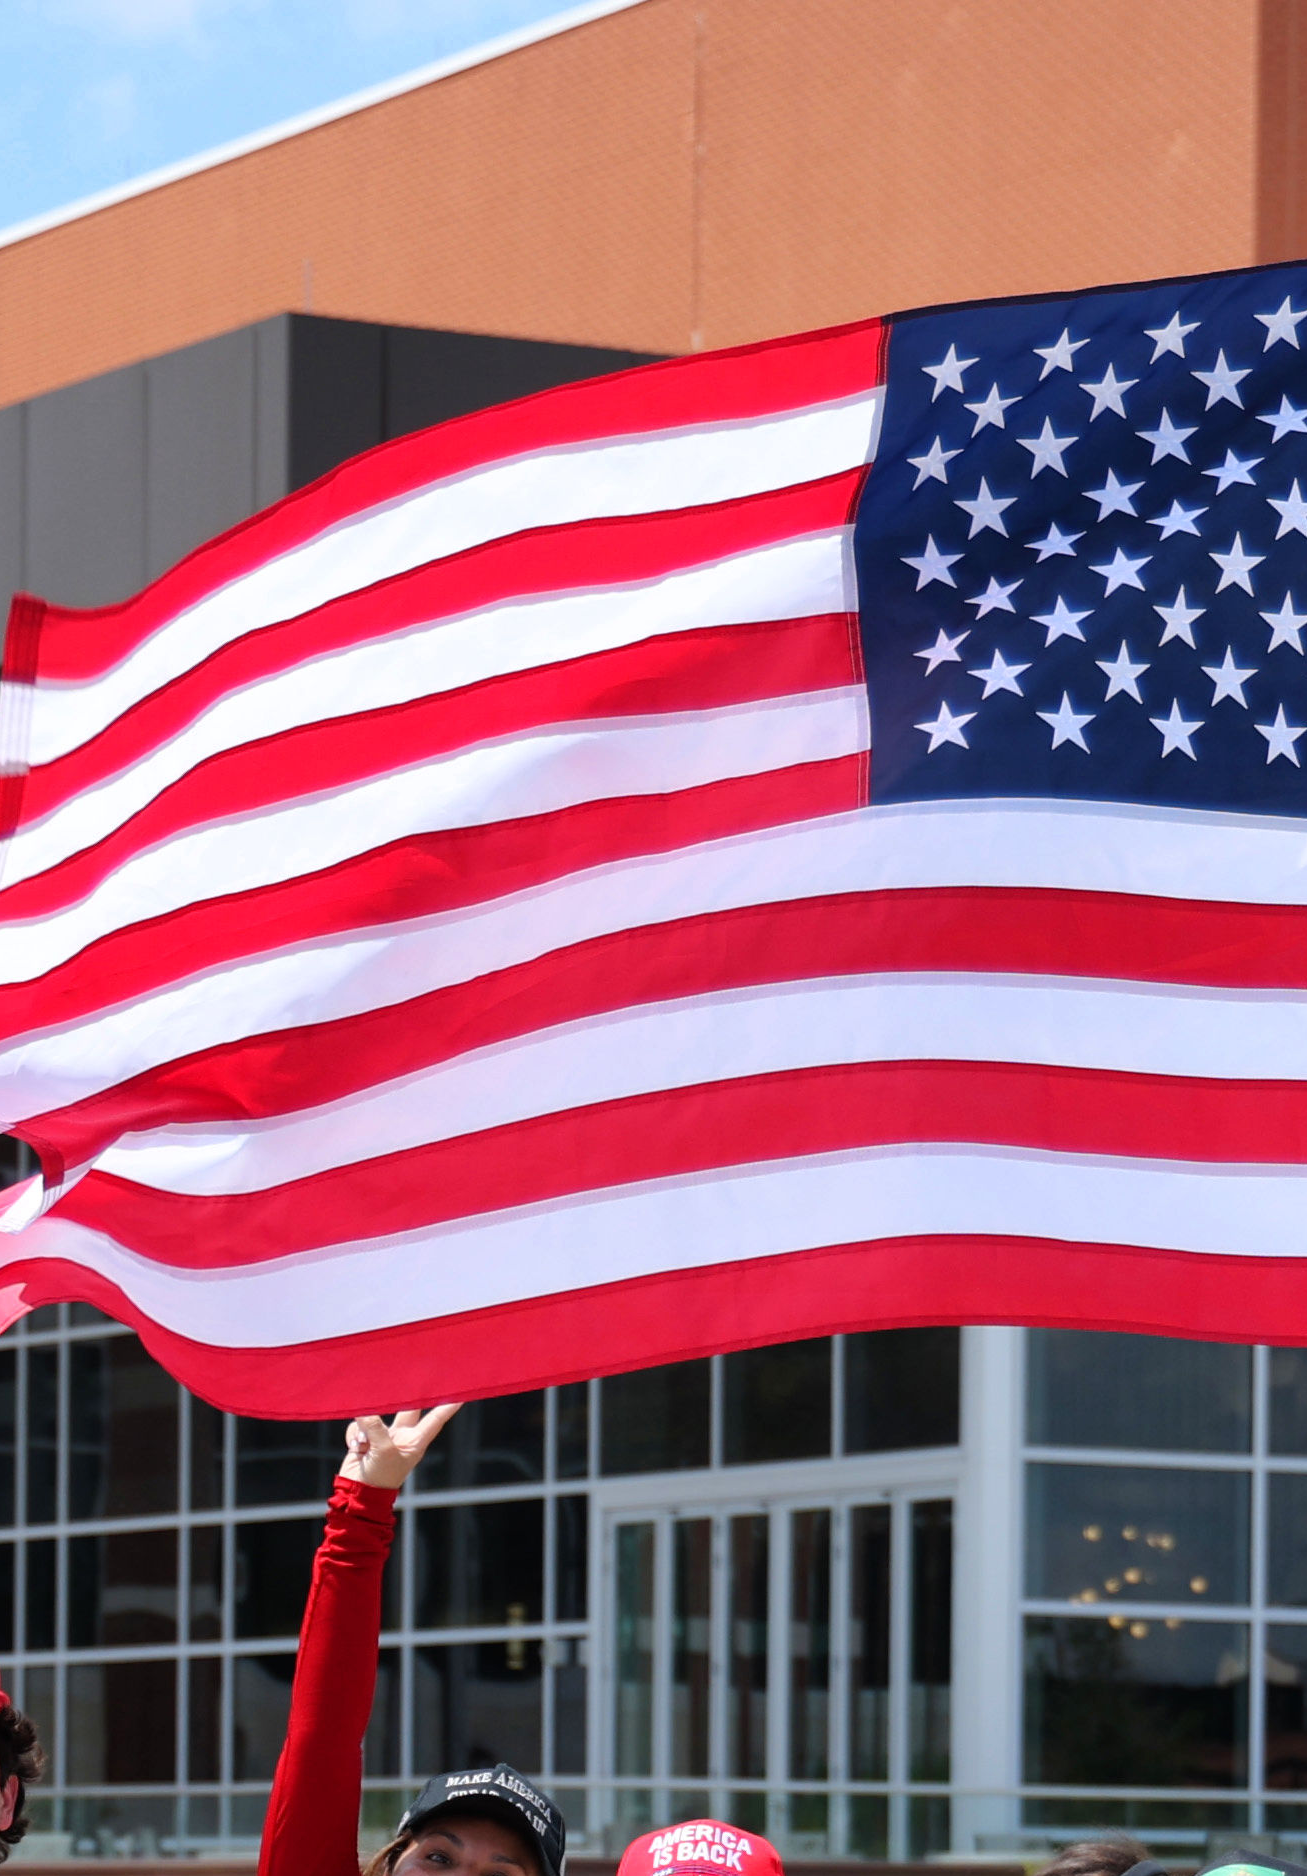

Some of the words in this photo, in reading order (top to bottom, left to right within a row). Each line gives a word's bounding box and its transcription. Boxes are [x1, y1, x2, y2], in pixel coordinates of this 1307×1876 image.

[445, 1772, 494, 1788] MAKE
[493, 1772, 553, 1824] AMERICA
[648, 1823, 753, 1855] AMERICA
[652, 1846, 674, 1869] IS
[676, 1841, 742, 1872] BACK
